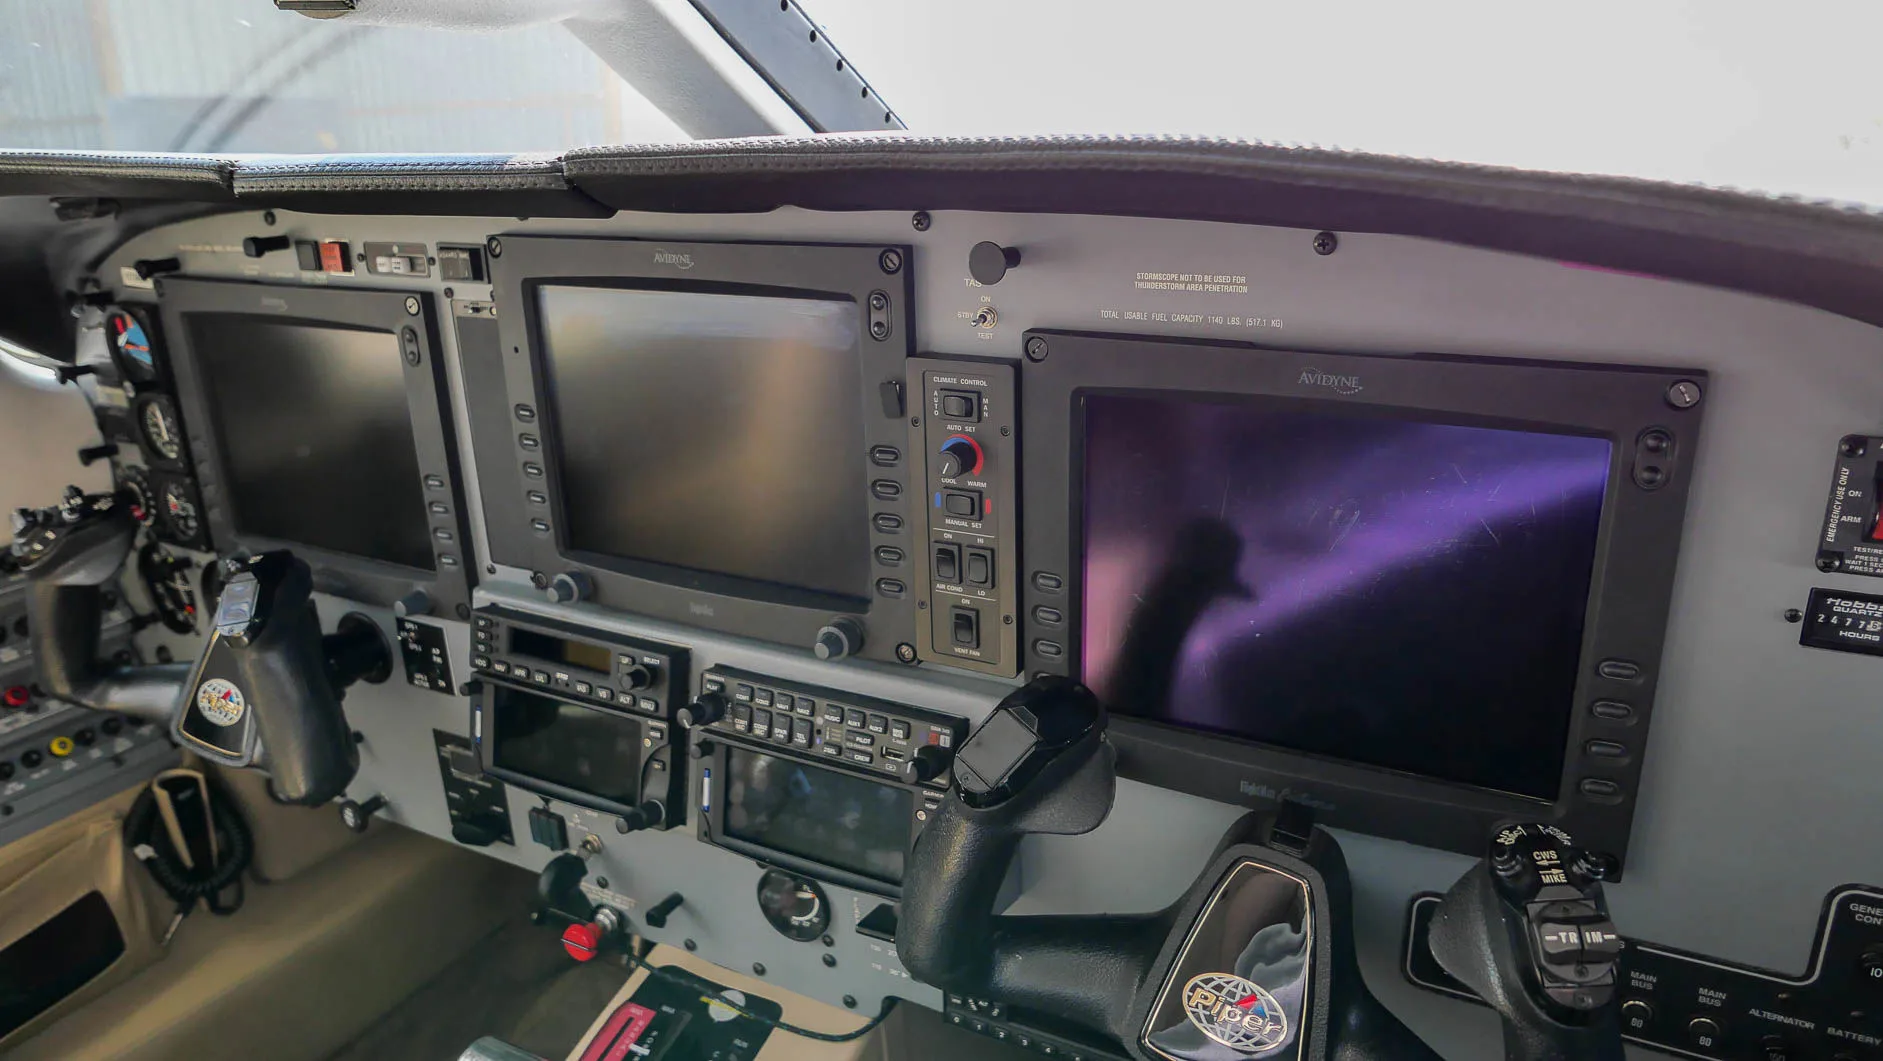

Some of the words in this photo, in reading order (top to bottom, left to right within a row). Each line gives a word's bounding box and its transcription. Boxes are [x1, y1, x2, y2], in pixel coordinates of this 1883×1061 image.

[653, 252, 691, 264] AVIDYNE
[1136, 272, 1179, 281] STORMSCOPE
[1180, 274, 1192, 282] NOT
[1194, 274, 1203, 282] TO
[1213, 275, 1231, 283] USED
[1232, 276, 1246, 284] FOR
[1134, 281, 1185, 291] THUNDERSTORM
[1186, 283, 1203, 292] AREA
[1204, 284, 1248, 293] PENETRATION
[980, 295, 992, 303] ON
[957, 311, 975, 319] STBY
[1100, 309, 1120, 319] TOTAL
[1124, 311, 1148, 321] USABLE
[1151, 312, 1168, 322] FUEL
[1171, 313, 1204, 323] CAPACITY
[1207, 315, 1224, 325] 1140
[1246, 318, 1267, 328] (517.1
[1271, 319, 1283, 329] KG)
[978, 332, 993, 340] TEST
[933, 376, 958, 384] CLIMATE
[960, 378, 988, 387] CONTROL
[1297, 371, 1360, 388] AVIDYNE
[964, 425, 976, 433] SET
[941, 477, 957, 485] COOL
[1838, 467, 1850, 486] ONLY
[967, 480, 987, 489] WARM
[1835, 486, 1846, 501] USE
[945, 518, 969, 527] MANUAL
[1826, 500, 1842, 542] EMERGENCY
[1840, 515, 1862, 523] ARM
[1848, 565, 1874, 573] PRESS
[946, 585, 964, 593] COND
[1832, 606, 1883, 618] QUARTZ
[1839, 630, 1880, 642] HOURS
[953, 647, 968, 656] VENT
[969, 649, 981, 657] FAN
[735, 693, 750, 701] COM1
[755, 697, 770, 706] COM2
[776, 703, 789, 711] NAV1
[796, 707, 810, 716] NAV2
[847, 719, 861, 727] AUX1
[869, 724, 883, 733] AUX2
[855, 736, 872, 744] PILOT
[1532, 850, 1558, 861] CWS
[1541, 873, 1568, 884] MIKE
[1849, 903, 1883, 917] GENE
[1855, 913, 1883, 926] CON
[1630, 970, 1657, 983] MAIN
[1631, 979, 1653, 990] BUS
[1698, 987, 1727, 1000] MAIN
[1698, 995, 1721, 1007] BUS
[1187, 987, 1283, 1036] Piper
[1748, 1008, 1816, 1030] ALTERNATOR
[1827, 1026, 1882, 1046] BATTERY
